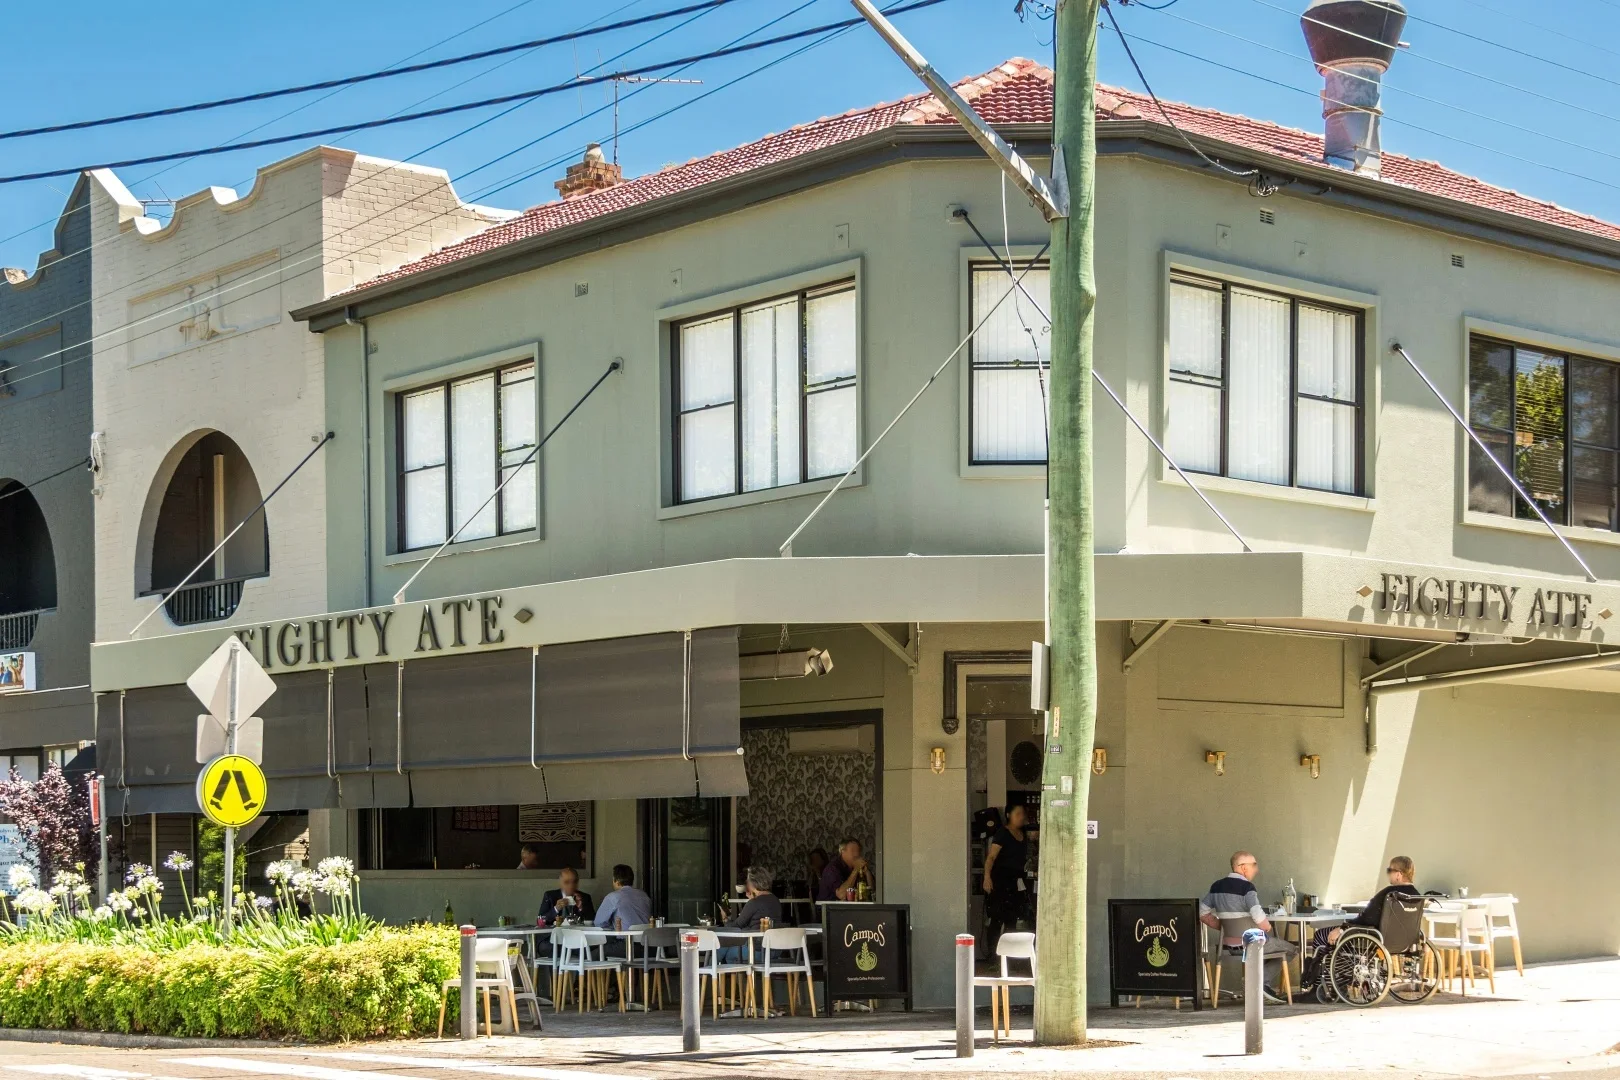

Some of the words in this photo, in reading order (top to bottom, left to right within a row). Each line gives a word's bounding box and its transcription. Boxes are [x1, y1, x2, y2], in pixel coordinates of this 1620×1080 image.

[414, 595, 504, 652] ATE
[1380, 572, 1521, 623] EIGHTY
[1527, 587, 1593, 630] ATE
